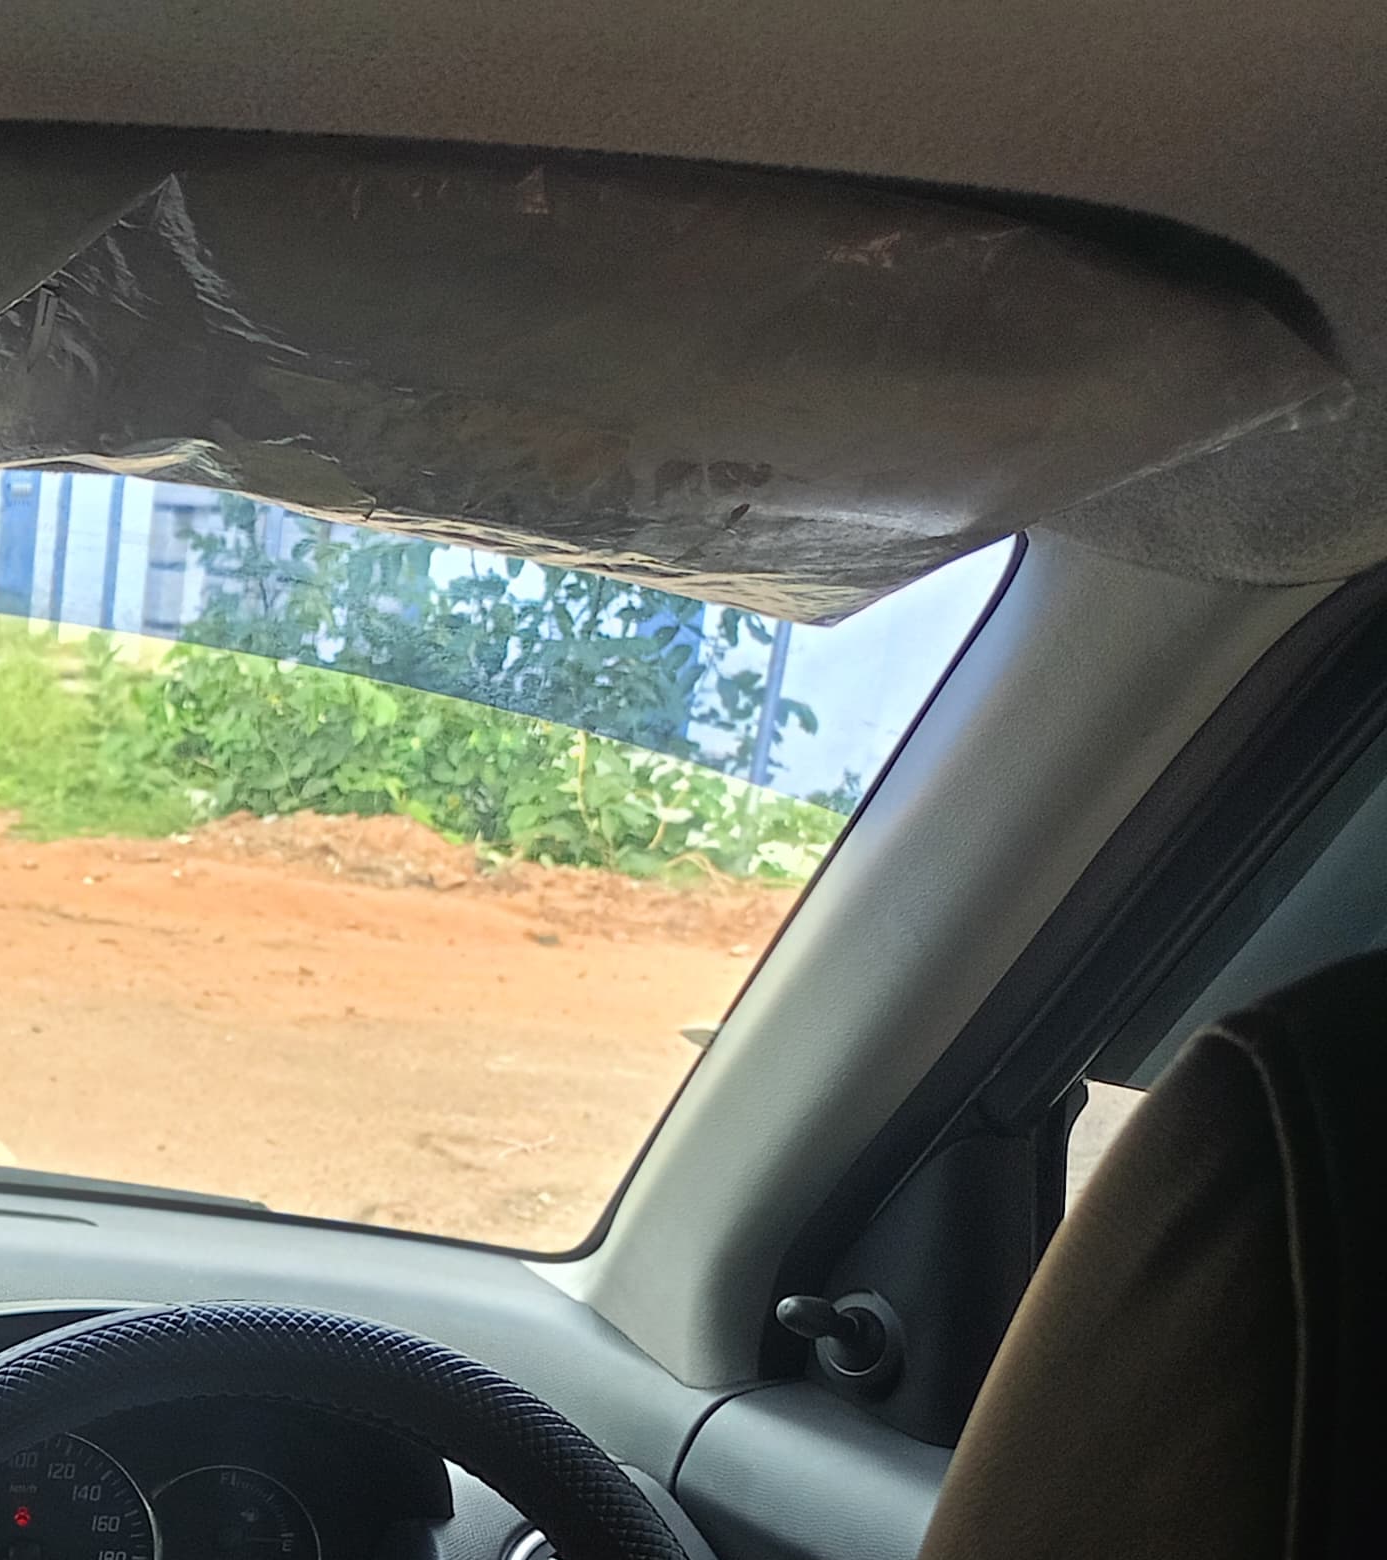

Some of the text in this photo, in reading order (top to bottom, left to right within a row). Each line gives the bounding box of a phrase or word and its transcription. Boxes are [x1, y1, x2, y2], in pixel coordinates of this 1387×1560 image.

[47, 1463, 76, 1480] 120
[72, 1484, 102, 1502] 140
[91, 1516, 121, 1533] 160
[281, 1540, 292, 1553] E
